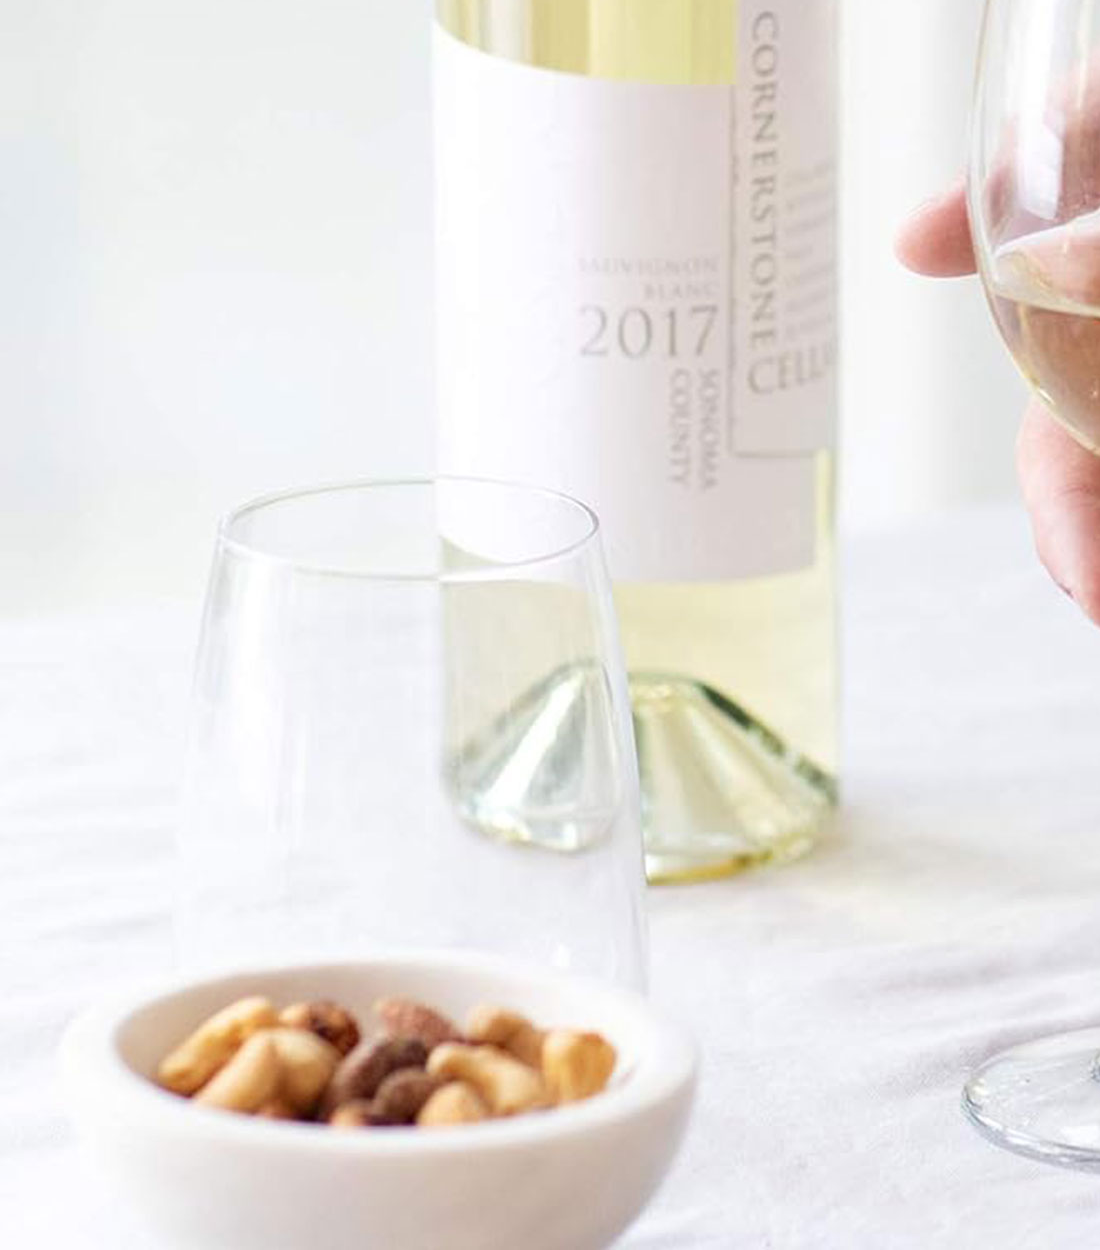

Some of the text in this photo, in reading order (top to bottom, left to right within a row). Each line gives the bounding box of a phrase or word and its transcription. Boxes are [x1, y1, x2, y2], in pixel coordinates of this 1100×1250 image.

[752, 10, 778, 348] CORNERSTONE
[579, 304, 719, 359] 2017
[668, 369, 690, 487] COUNTY
